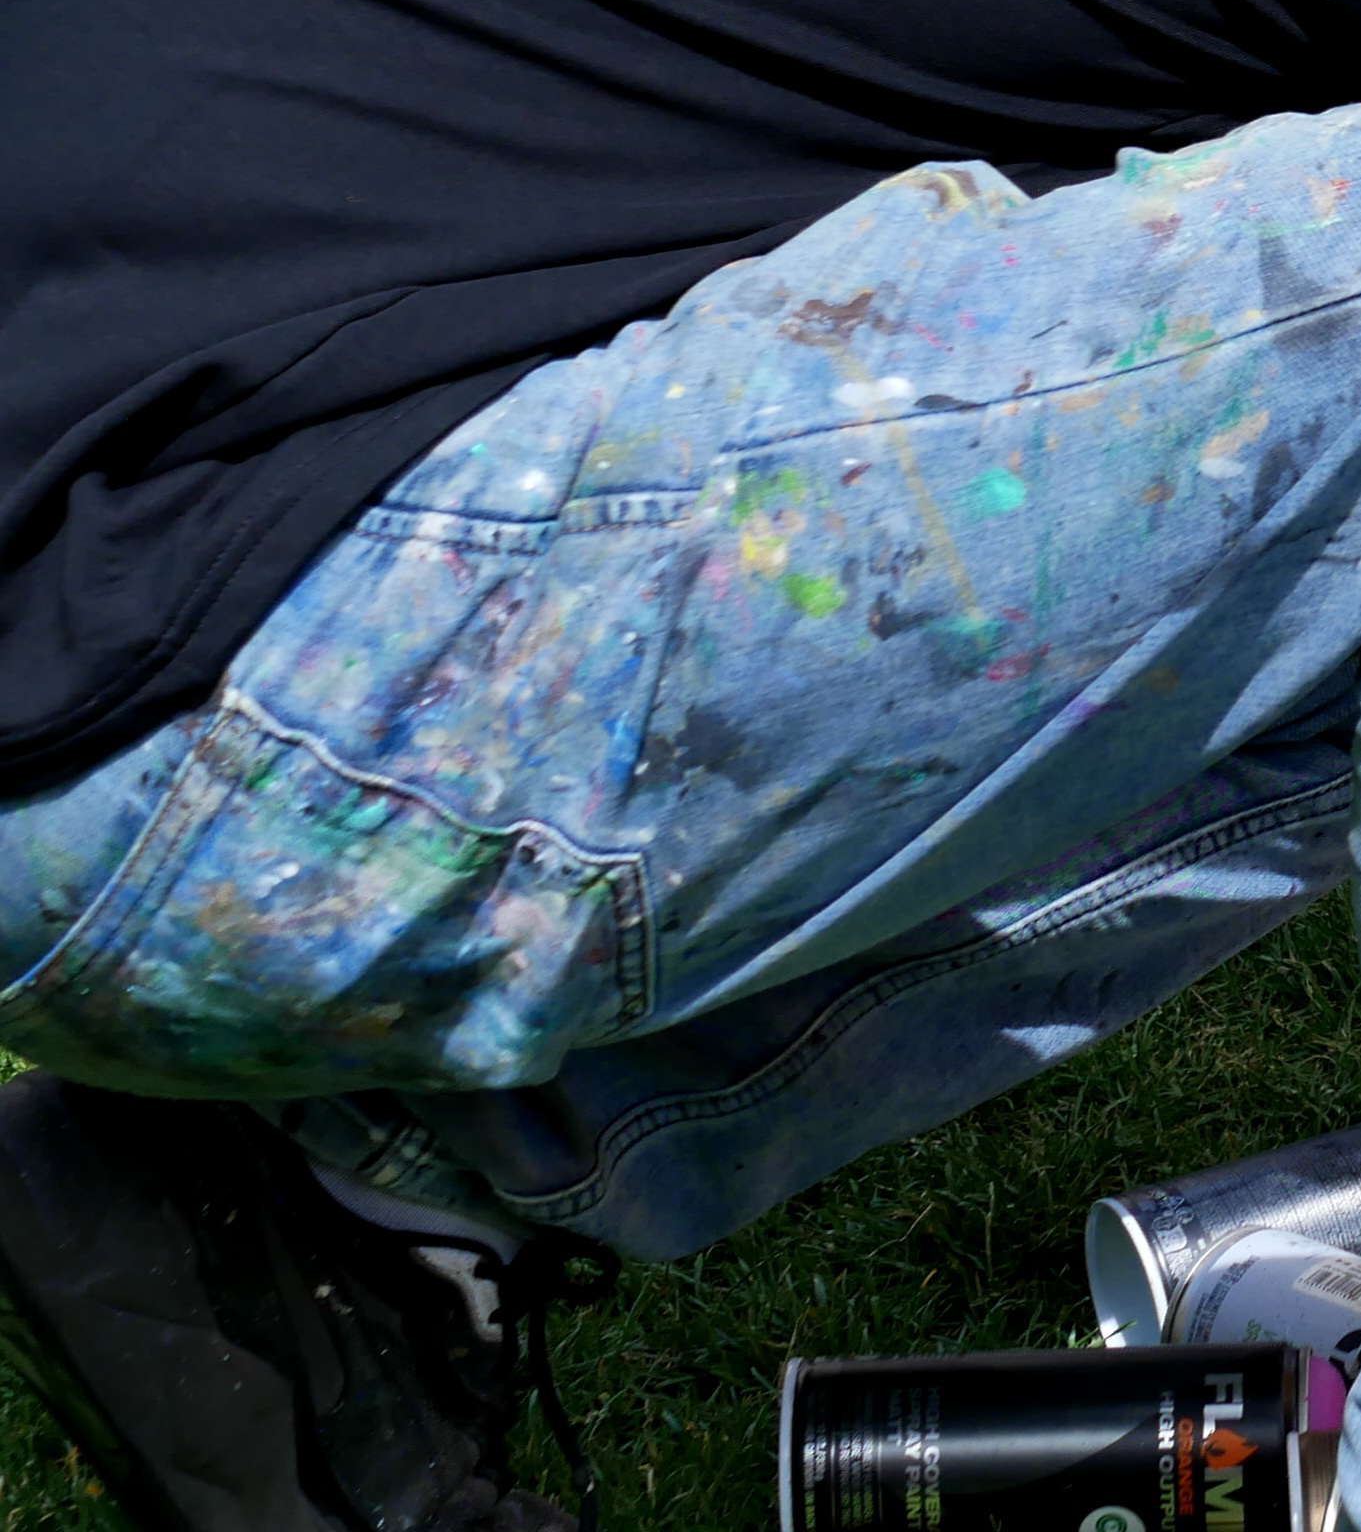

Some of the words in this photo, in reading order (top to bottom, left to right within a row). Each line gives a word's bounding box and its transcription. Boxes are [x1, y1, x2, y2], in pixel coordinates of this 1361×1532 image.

[1158, 1389, 1176, 1451] HIGH
[904, 1464, 922, 1531] PAINT
[923, 1444, 942, 1532] COVER
[1158, 1453, 1176, 1532] OUTPU
[1177, 1417, 1195, 1517] ORANGE
